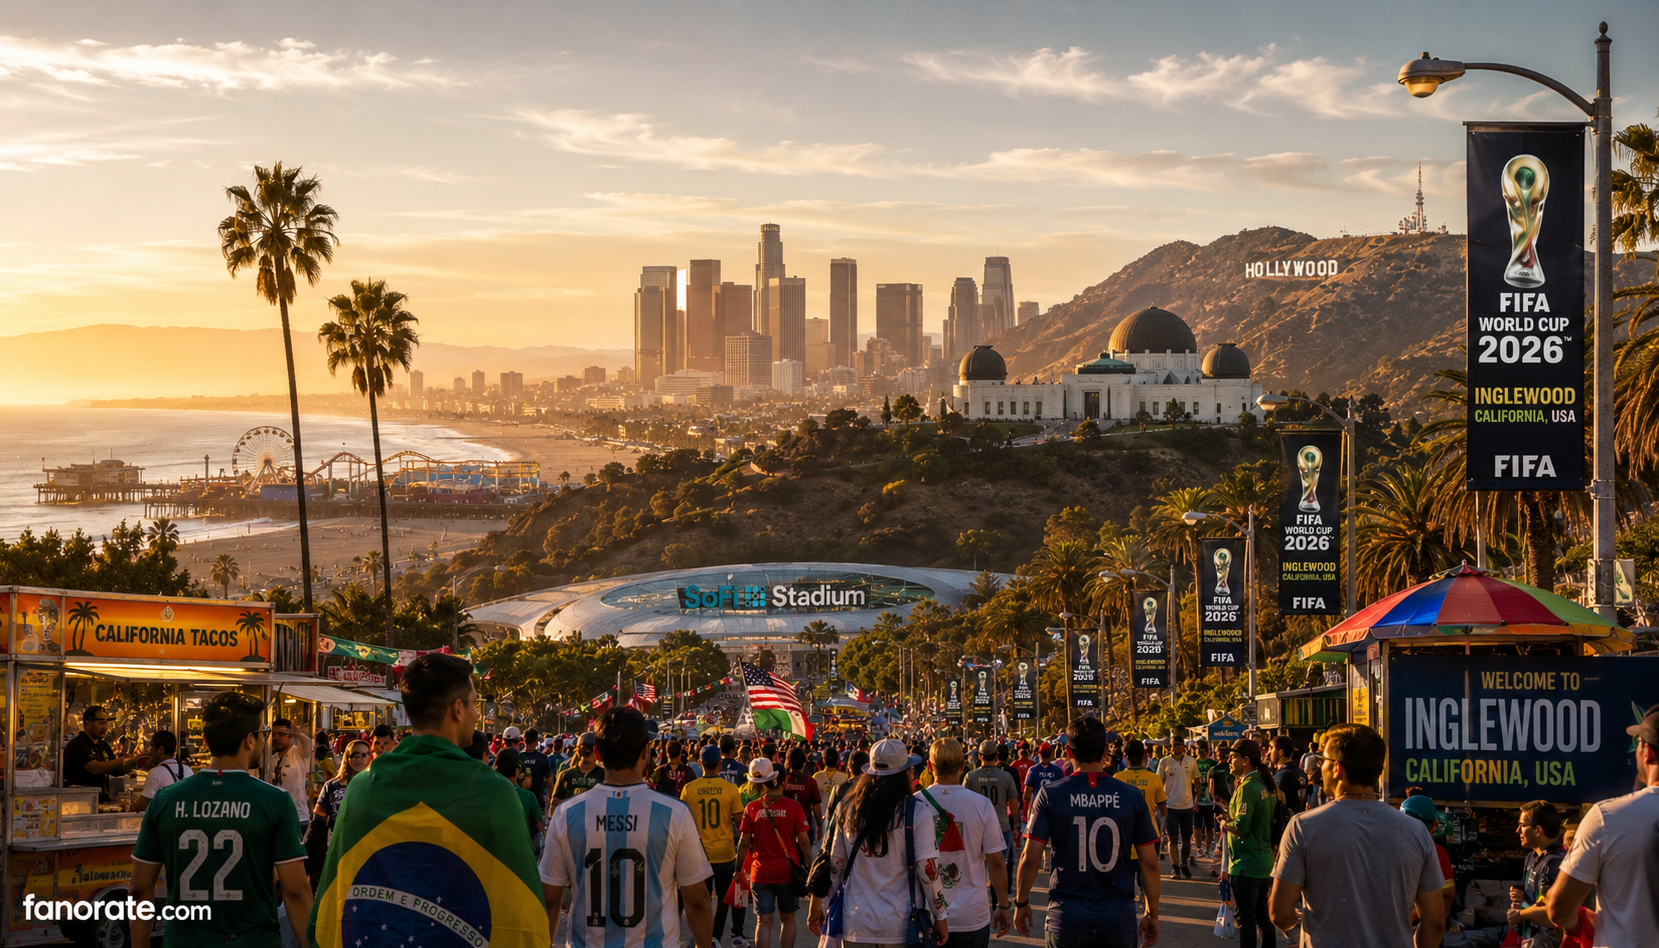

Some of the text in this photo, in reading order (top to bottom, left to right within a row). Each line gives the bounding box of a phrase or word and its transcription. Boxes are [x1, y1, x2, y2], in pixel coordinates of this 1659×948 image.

[1245, 260, 1338, 278] HOLLYWOOD
[1500, 292, 1550, 312] FIFA
[1479, 317, 1569, 332] WORLD CUP
[1475, 387, 1576, 405] INGLEWOOD
[1475, 409, 1576, 424] CALIFORNIA, USA
[1494, 455, 1557, 478] FIFA
[1296, 514, 1322, 525] FIFA
[1285, 526, 1332, 535] WORLD CUP
[1282, 562, 1336, 572] INGLEWOOD
[1323, 573, 1336, 581] USA
[684, 584, 865, 608] SoFi Stadium
[1293, 597, 1326, 609] FIFA
[95, 624, 238, 648] CALIFORNIA TACOS
[1211, 653, 1235, 662] FIFA
[1481, 671, 1580, 690] WELCOME TO
[1404, 696, 1602, 754] INGLEWOOD
[1405, 758, 1576, 788] CALIFORNIA, USA
[1070, 792, 1120, 808] MBAPPÉ
[175, 801, 251, 819] H. LOZANO
[698, 798, 720, 829] 10
[596, 815, 638, 832] MESSI
[1072, 816, 1120, 872] 10
[178, 829, 243, 901] 22
[585, 848, 645, 928] 10
[352, 886, 484, 948] ORDEM E PROGRESSO
